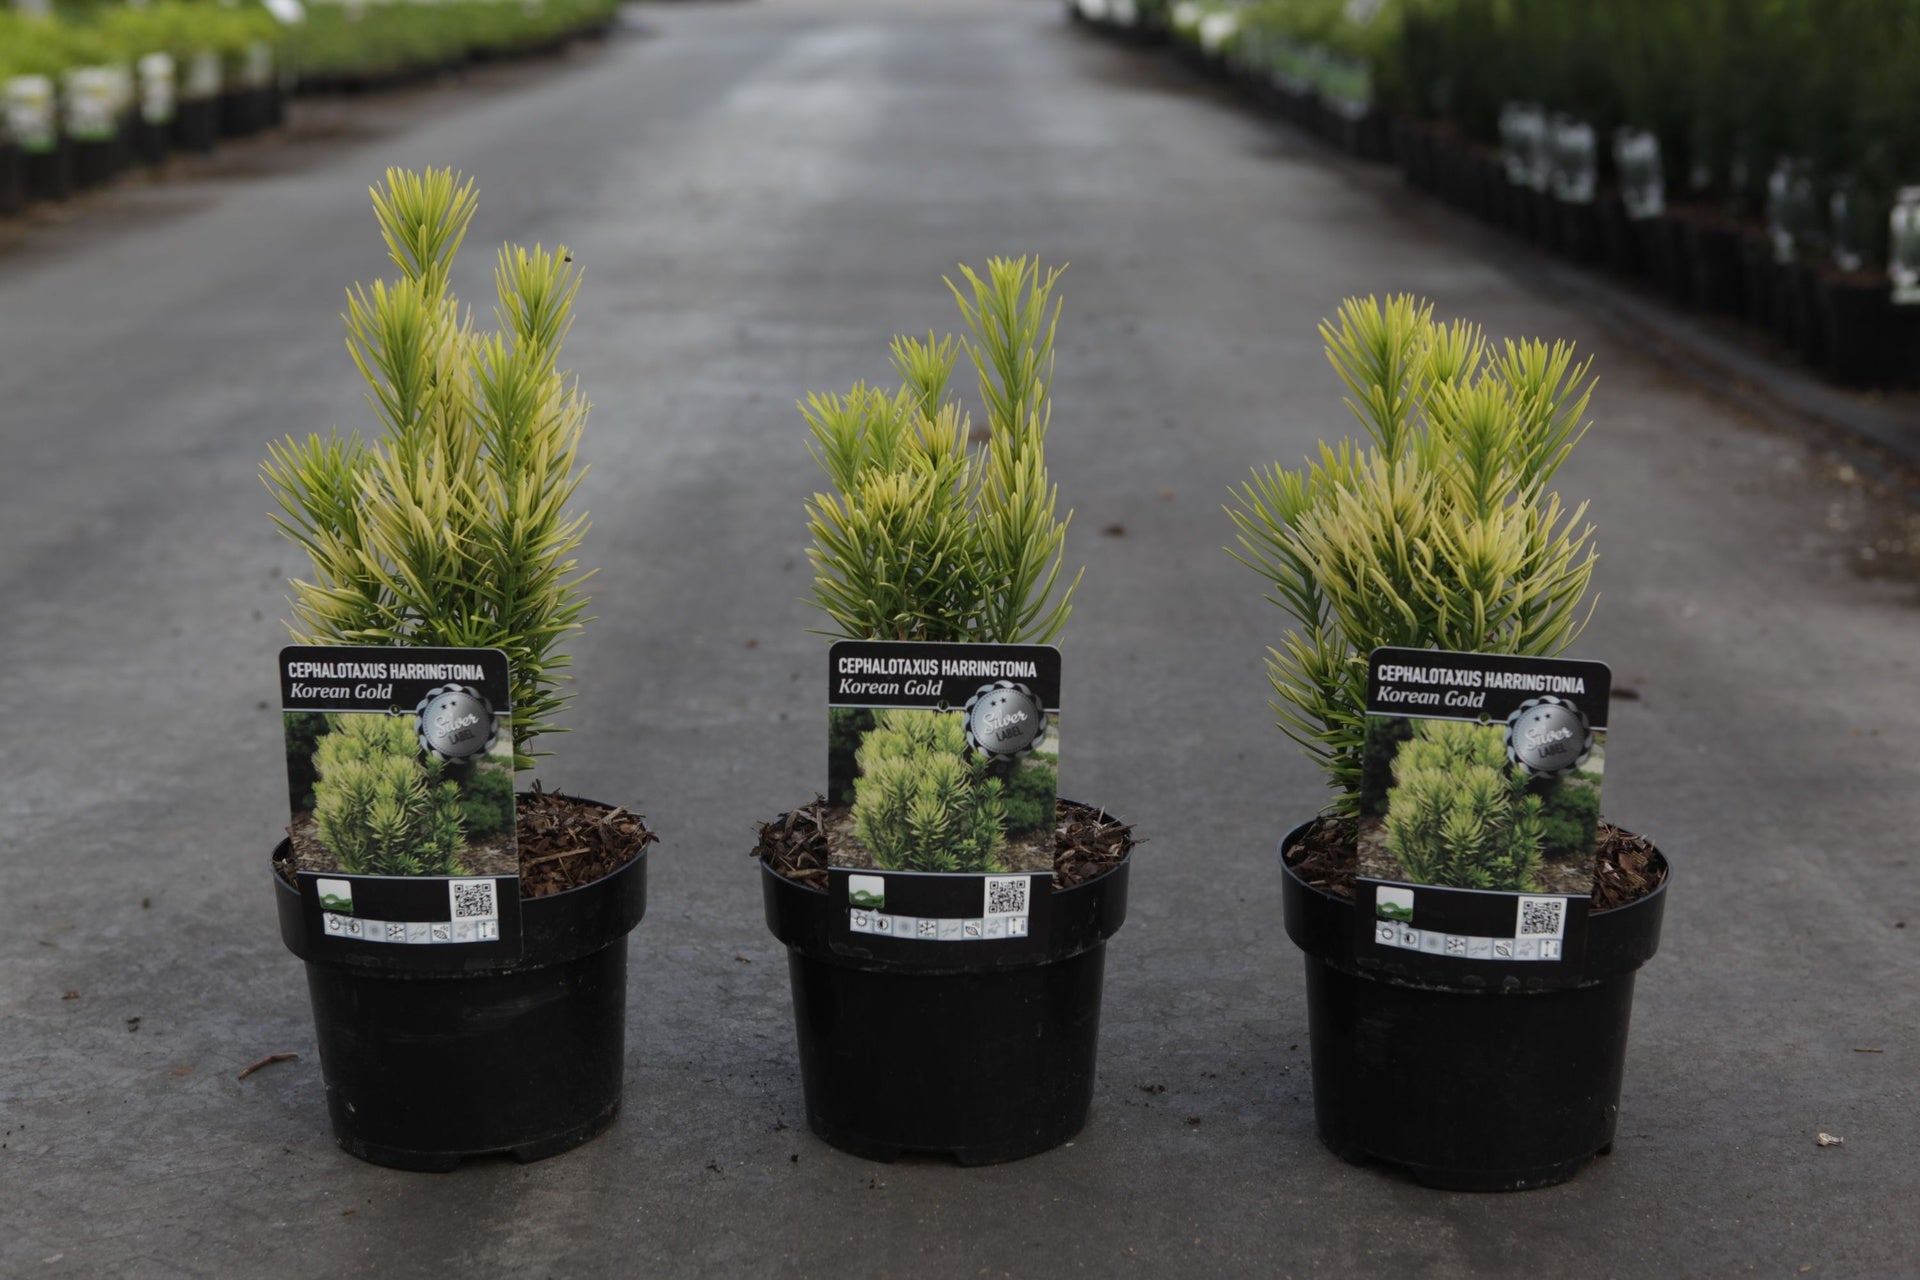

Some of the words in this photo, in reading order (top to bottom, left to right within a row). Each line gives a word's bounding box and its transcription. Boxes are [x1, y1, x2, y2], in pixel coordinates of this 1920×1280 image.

[288, 662, 387, 679] CEPHALOTAXUS
[390, 663, 485, 681] HARRINGTONIA
[838, 658, 939, 675] CEPHALOTAXUS
[941, 660, 1037, 678] HARRINGTONIA
[838, 678, 899, 695] Korean
[904, 679, 943, 696] Gold
[1377, 664, 1482, 687] CEPHALOTAXUS
[1484, 671, 1585, 694] HARRINGTONIA
[290, 683, 350, 699] Korean
[354, 684, 393, 700] Gold
[1376, 685, 1440, 705] Korean
[1444, 689, 1486, 708] Gold
[436, 711, 479, 738] Silver
[983, 708, 1028, 734] Silver
[996, 725, 1023, 742] LABEL
